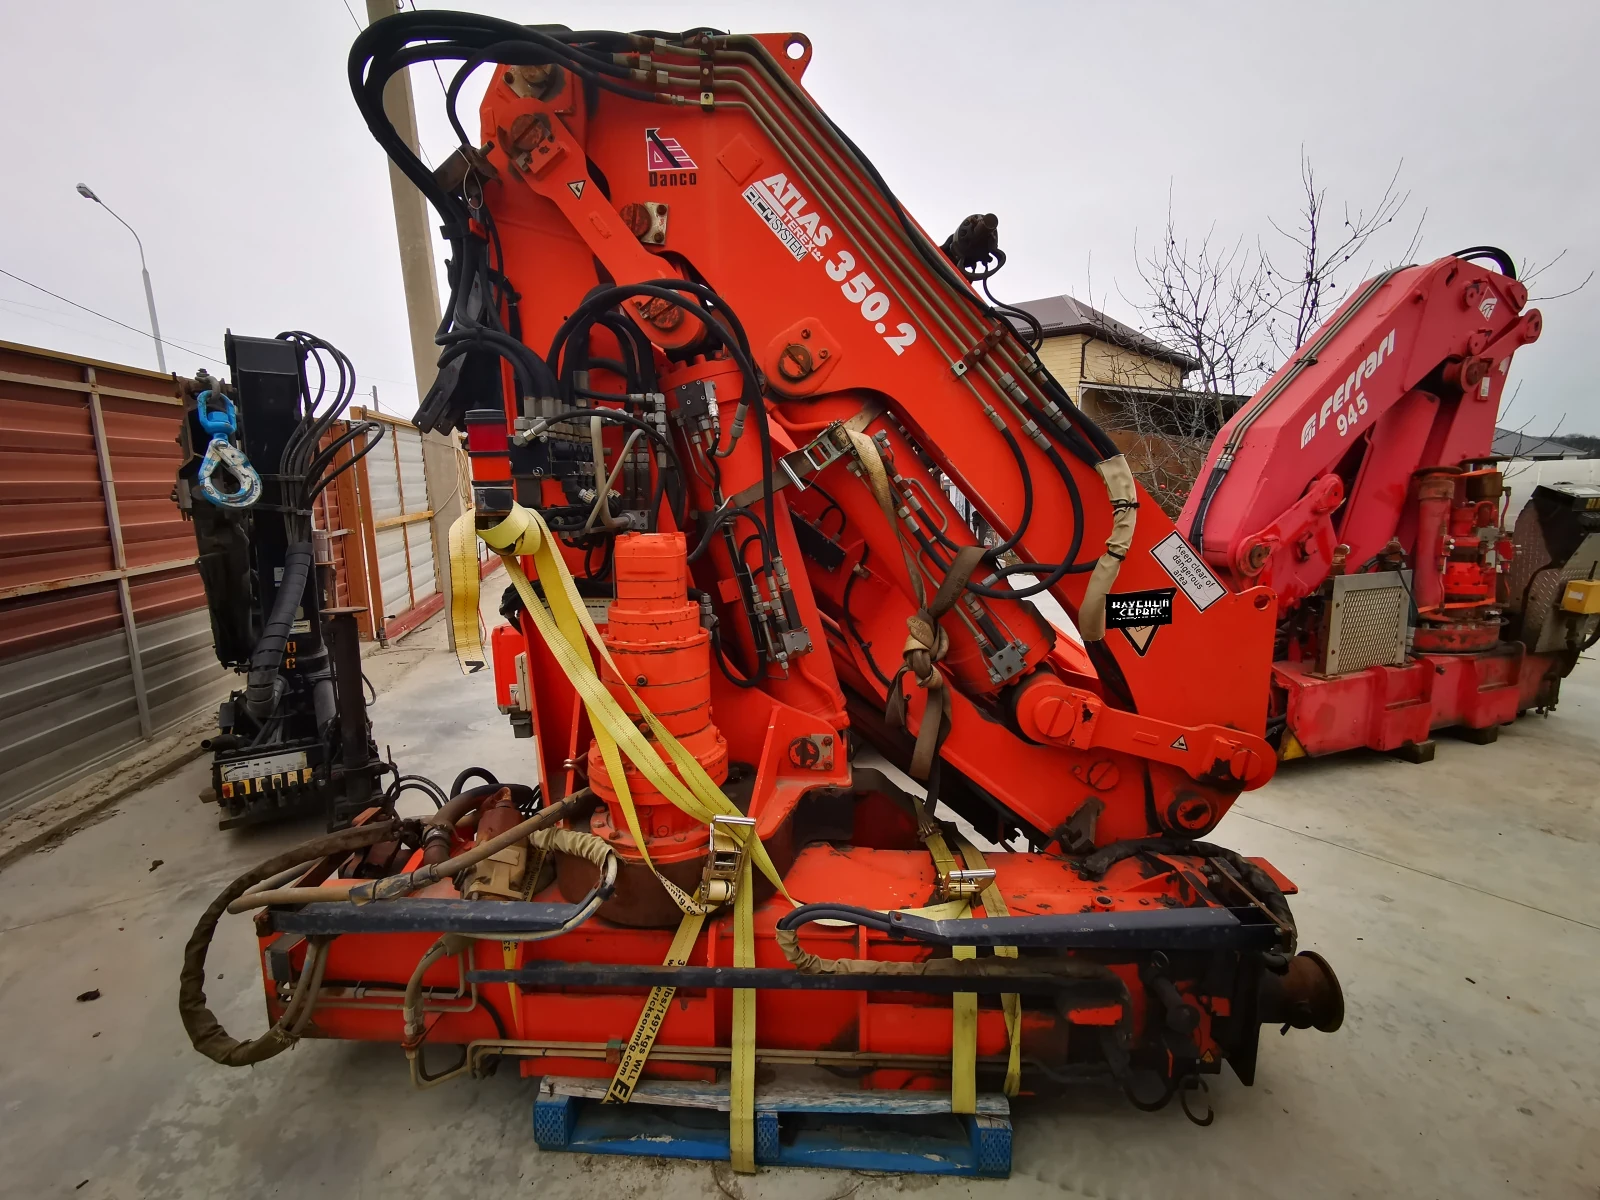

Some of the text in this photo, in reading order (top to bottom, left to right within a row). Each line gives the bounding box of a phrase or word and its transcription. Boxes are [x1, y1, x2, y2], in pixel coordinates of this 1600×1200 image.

[649, 171, 697, 187] Danco
[783, 212, 816, 252] TEREX
[762, 173, 917, 356] ATLAS 350.2
[1319, 328, 1396, 430] Ferrari
[1336, 391, 1369, 437] 945
[1172, 554, 1203, 590] dangerous
[1173, 569, 1188, 586] area
[1175, 543, 1216, 588] Keep clear of
[638, 1035, 653, 1055] kgs
[626, 1059, 643, 1081] WLL
